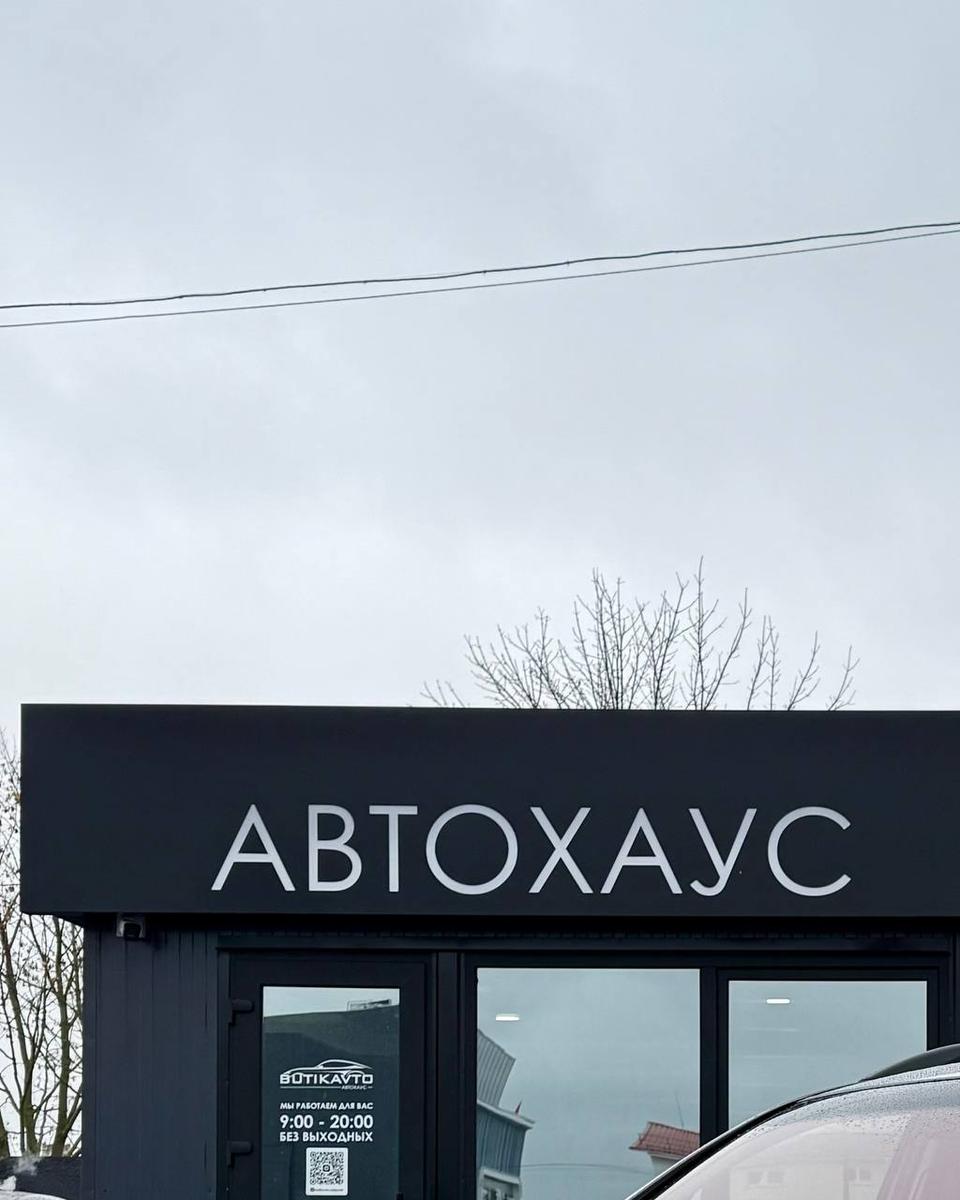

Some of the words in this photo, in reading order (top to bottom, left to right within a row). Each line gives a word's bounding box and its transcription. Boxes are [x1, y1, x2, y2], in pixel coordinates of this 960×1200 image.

[210, 803, 852, 897] АВТОХАУС
[280, 1073, 374, 1084] BUTIKAVTO
[280, 1102, 295, 1110] МЫ
[296, 1102, 338, 1110] РАБОТАЕМ
[338, 1102, 356, 1111] ДЛЯ
[356, 1102, 374, 1110] ВАС
[280, 1114, 314, 1129] 9:00
[329, 1114, 374, 1129] 20:00
[280, 1131, 300, 1142] БЕЗ
[302, 1131, 374, 1143] ВЫХОДНЫХ
